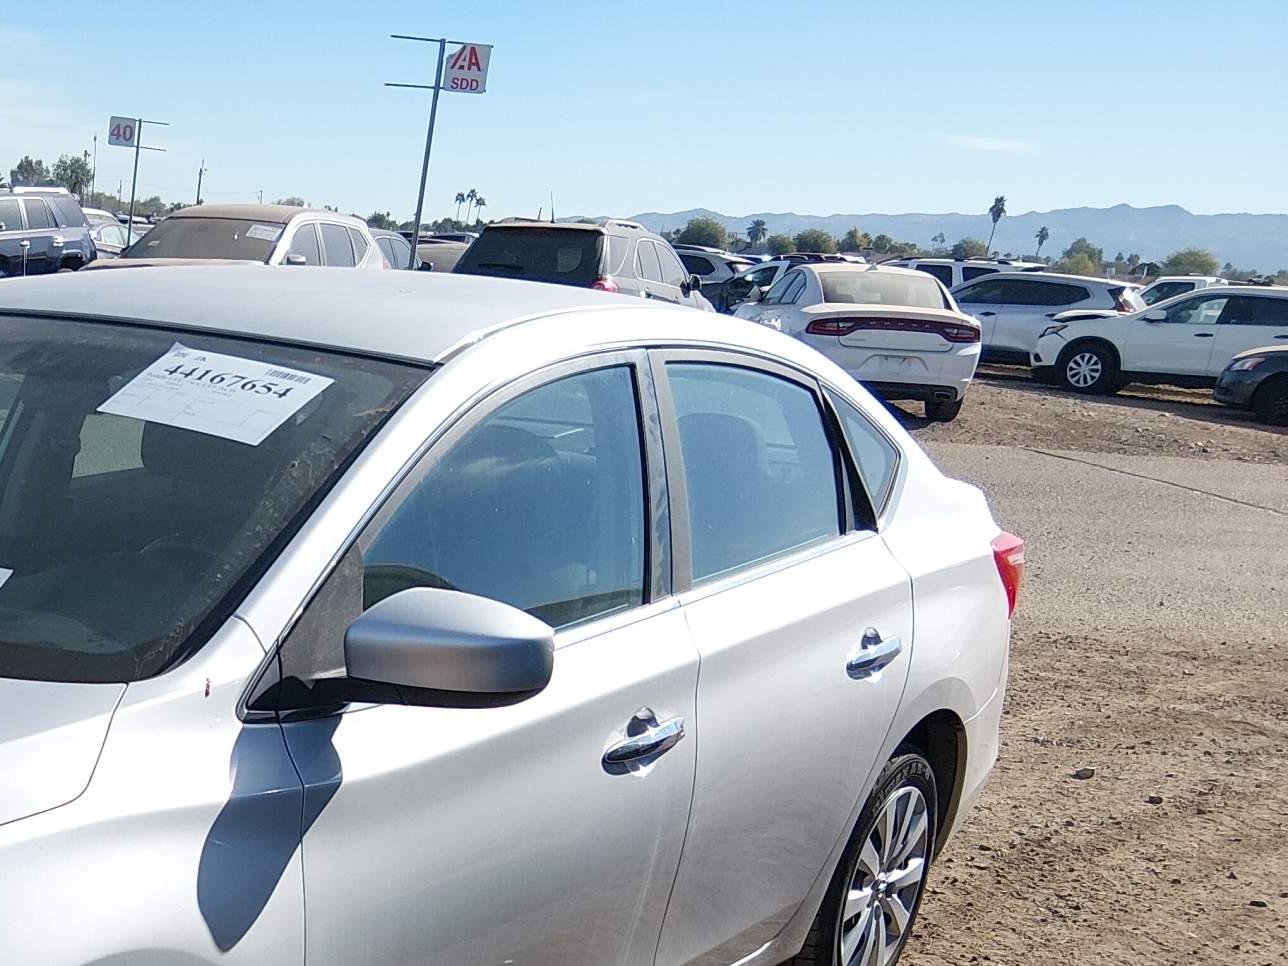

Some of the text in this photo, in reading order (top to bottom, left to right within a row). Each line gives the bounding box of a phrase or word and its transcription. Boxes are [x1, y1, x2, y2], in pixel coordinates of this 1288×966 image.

[450, 76, 479, 91] SDD
[111, 123, 134, 141] 40
[164, 363, 294, 399] 44167654
